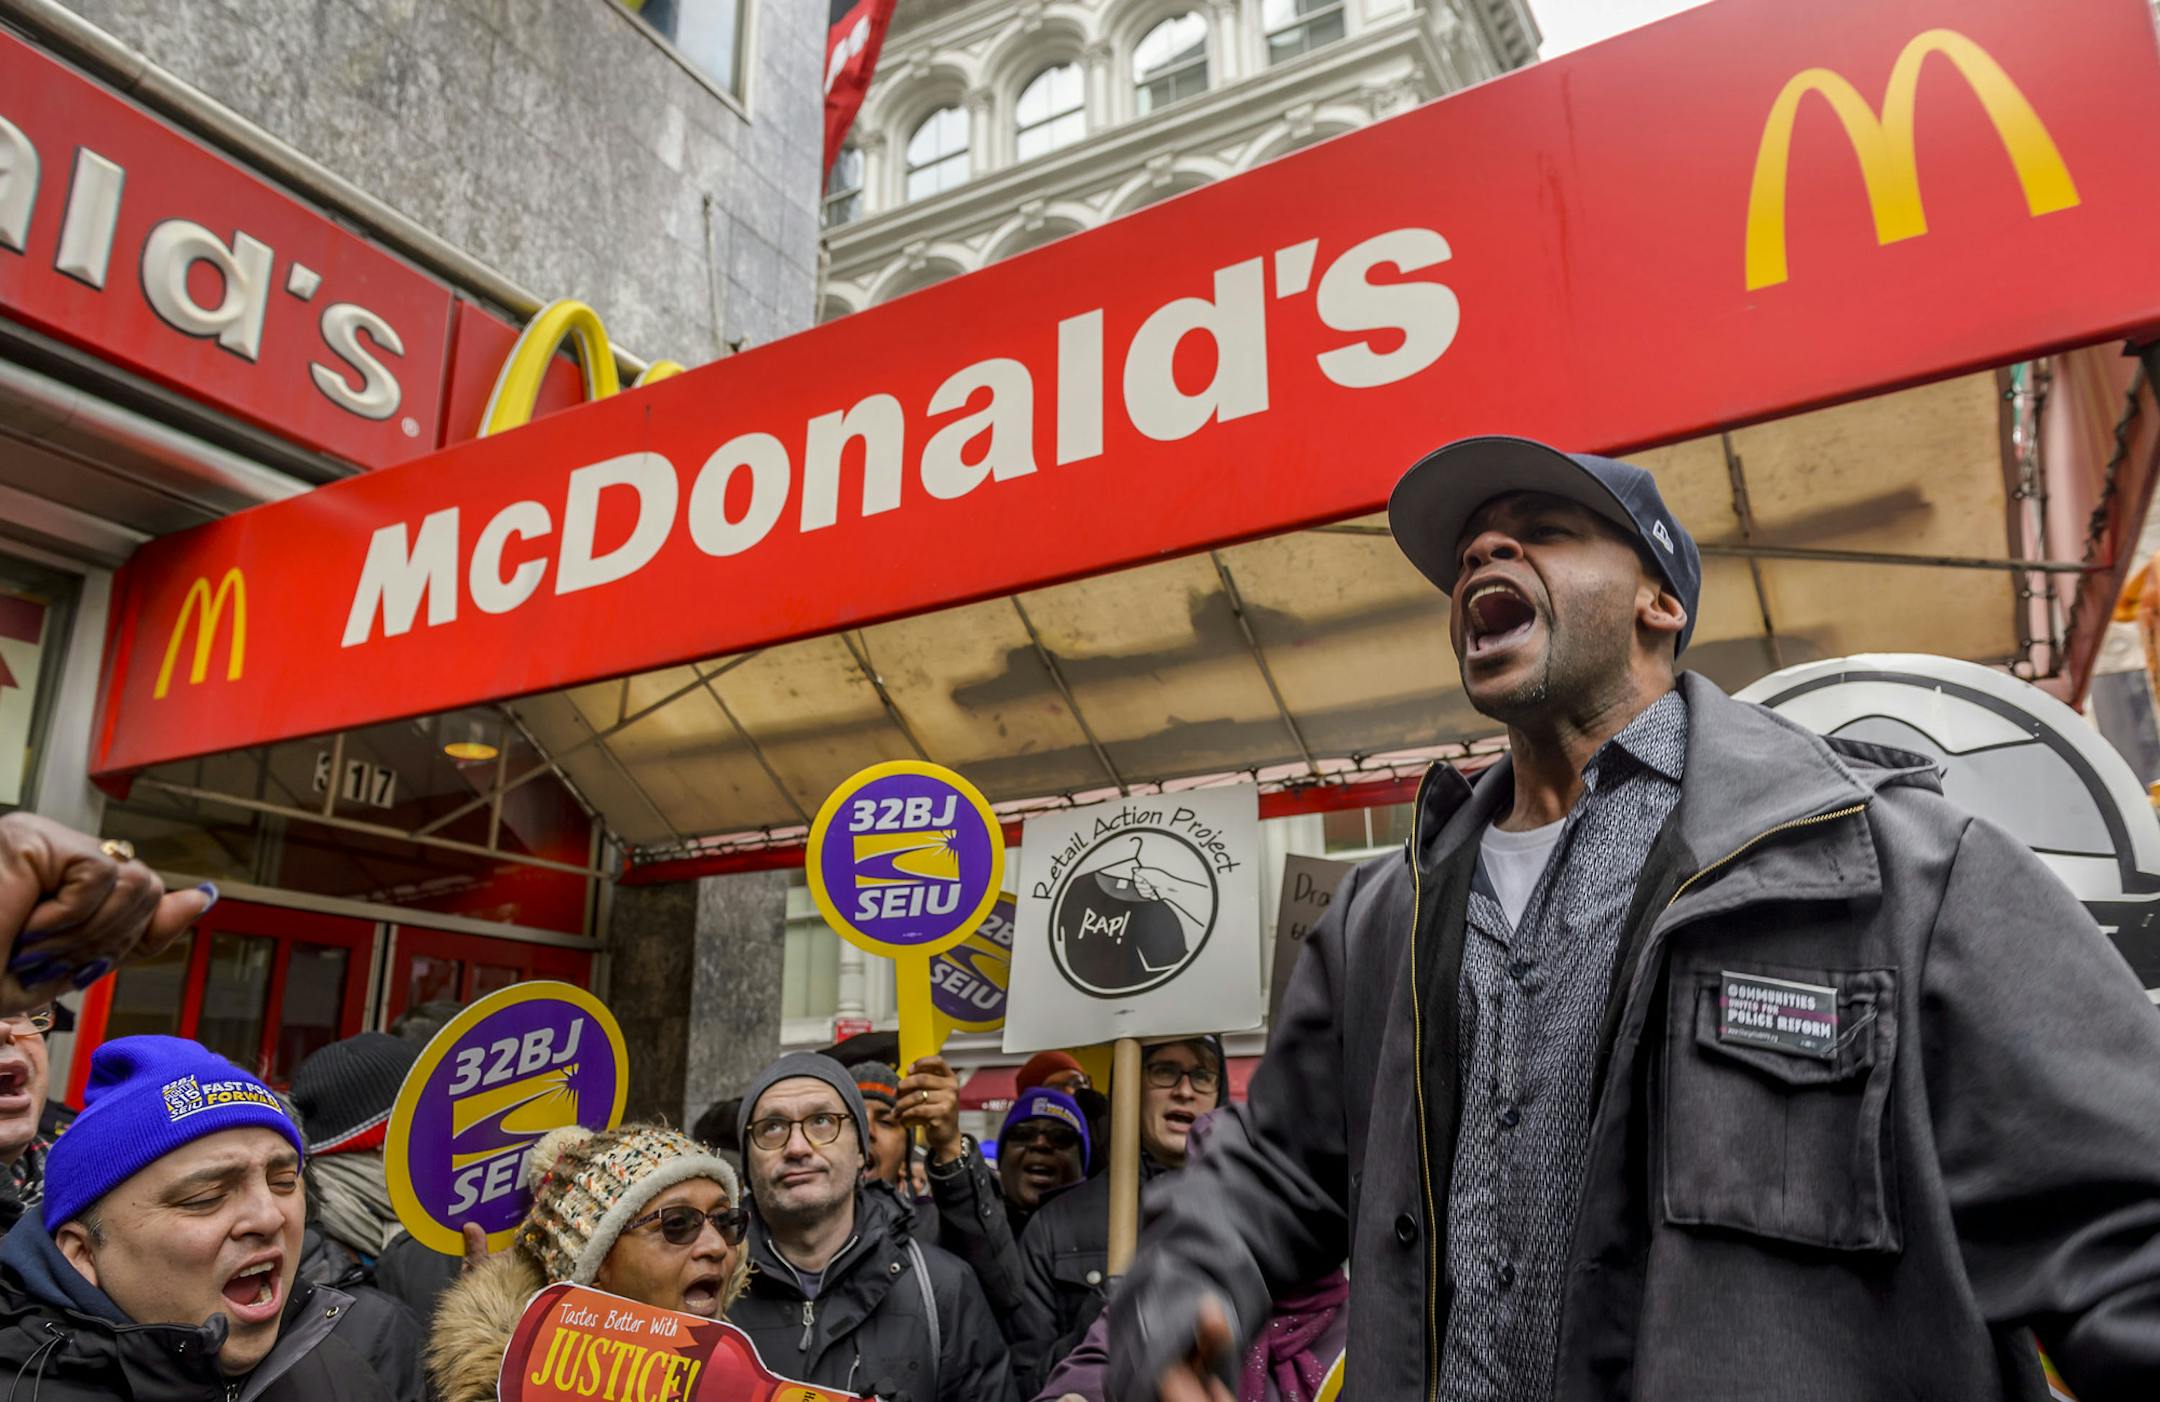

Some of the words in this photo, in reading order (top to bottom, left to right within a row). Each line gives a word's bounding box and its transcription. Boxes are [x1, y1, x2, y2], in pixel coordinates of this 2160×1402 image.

[340, 227, 1460, 648] McDonald's
[849, 795, 958, 832] 32BJ
[1032, 832, 1089, 900] Retail
[1093, 806, 1164, 840] Action
[1169, 806, 1241, 875] Project
[854, 882, 962, 922] SEIU
[976, 913, 1014, 945] 2B
[930, 962, 1004, 1011] SEIU
[449, 1018, 584, 1096] 32BJ
[202, 1081, 243, 1095] FAST
[448, 1150, 531, 1216] SEI
[560, 1303, 600, 1328] Tastes
[603, 1309, 645, 1333] Better
[650, 1316, 679, 1338] With
[531, 1327, 701, 1402] JUSTICE!
